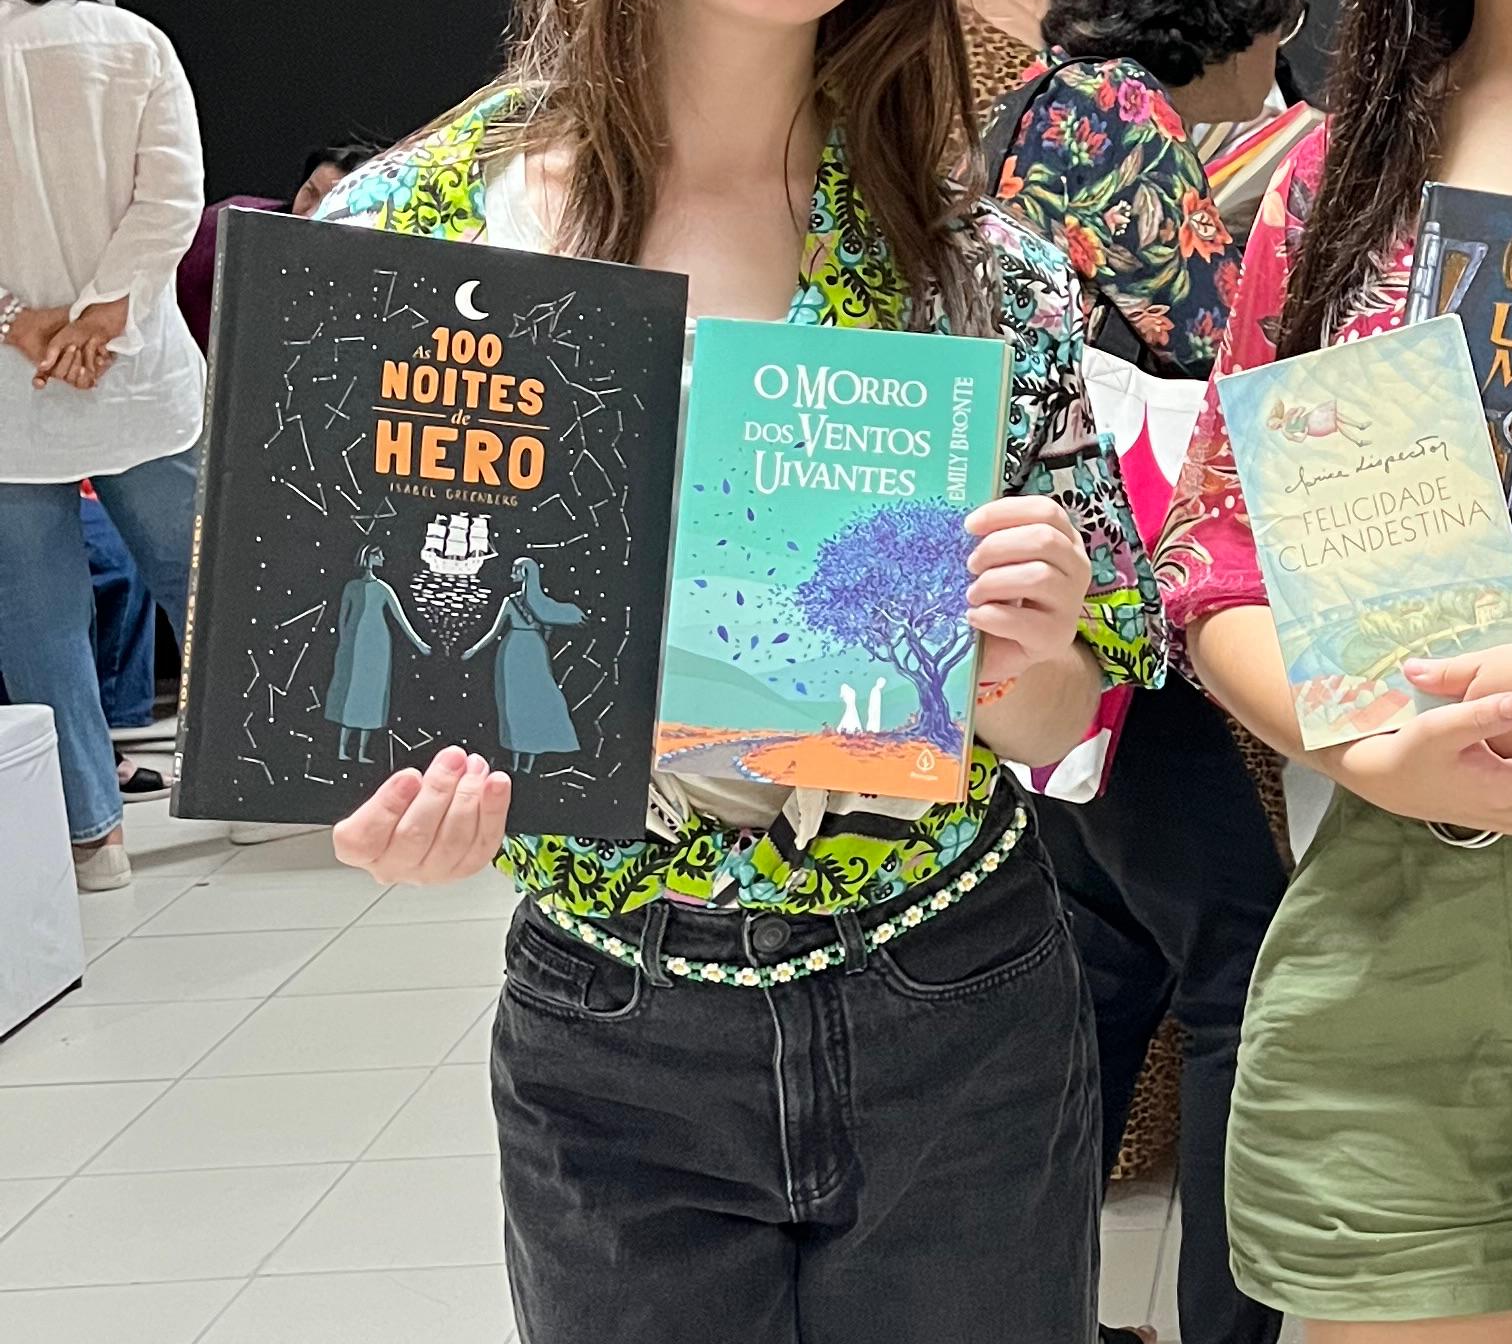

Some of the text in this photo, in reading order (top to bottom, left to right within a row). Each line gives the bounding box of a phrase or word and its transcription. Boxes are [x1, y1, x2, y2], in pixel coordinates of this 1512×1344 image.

[412, 326, 503, 368] As 100
[381, 359, 546, 416] NOITES
[753, 364, 928, 410] O MORRO
[450, 409, 472, 426] de
[798, 412, 932, 458] VENTOS
[374, 418, 546, 491] HERO
[754, 449, 917, 497] UIVANTES
[946, 453, 968, 502] EMILY
[389, 482, 519, 506] ISABEL GREENBERG
[1302, 475, 1452, 536] FELICIDADE
[1278, 499, 1492, 572] CLANDESTINA
